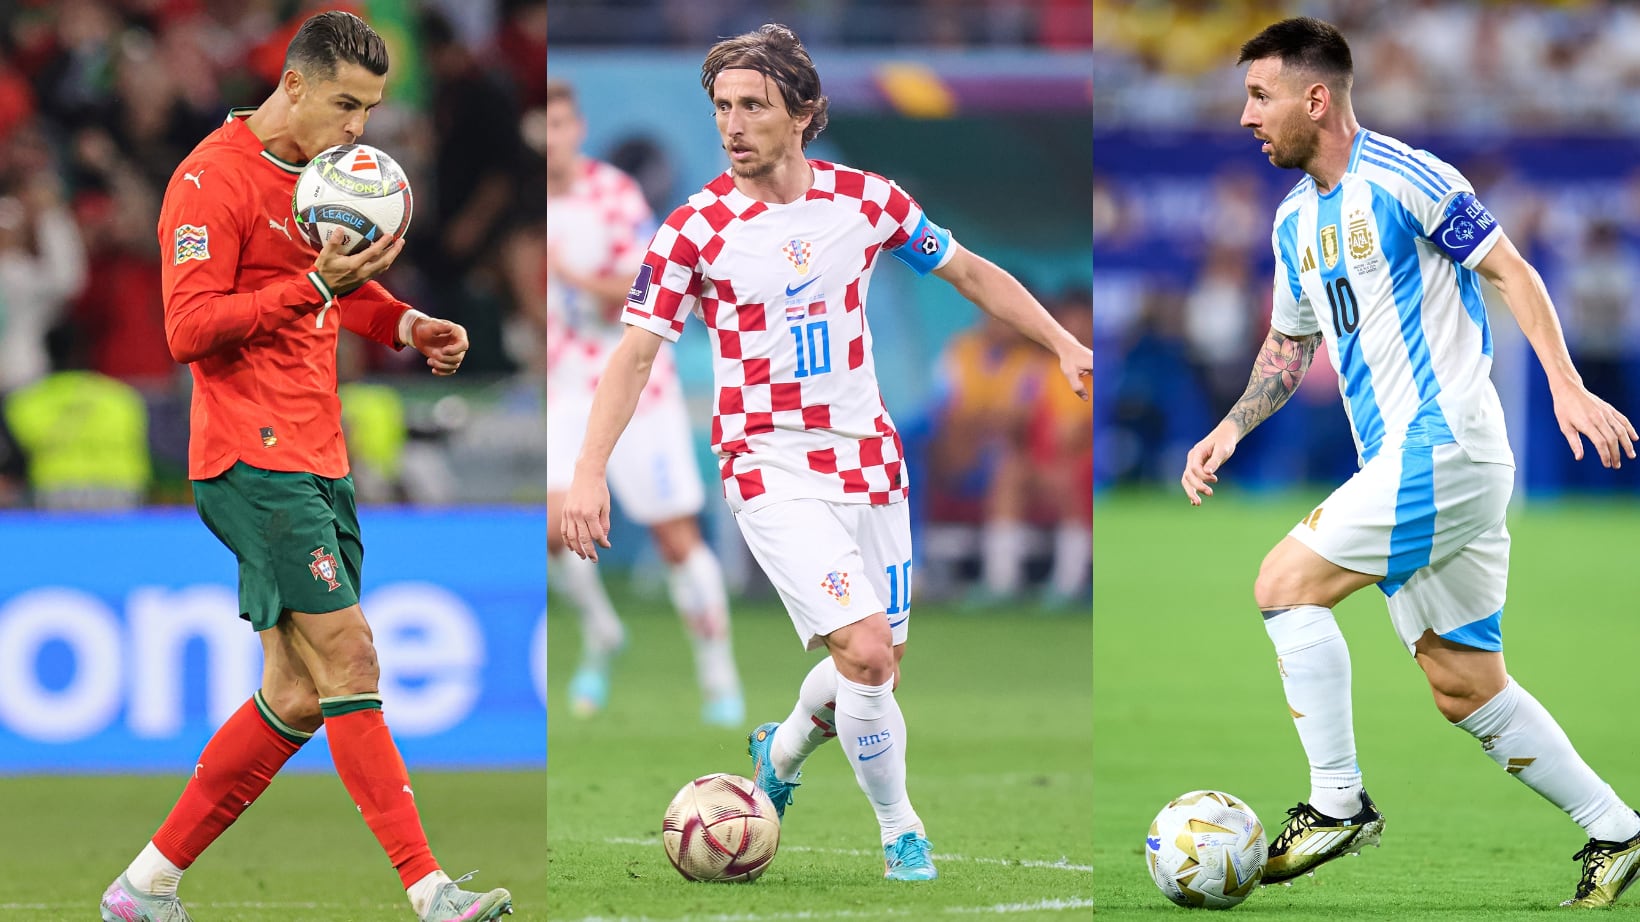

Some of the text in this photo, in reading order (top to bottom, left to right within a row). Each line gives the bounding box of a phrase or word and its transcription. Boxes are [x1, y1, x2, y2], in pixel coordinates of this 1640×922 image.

[330, 171, 379, 195] NATIONS
[322, 208, 365, 229] LEAGUE
[1326, 277, 1360, 337] 10
[790, 320, 831, 378] 10
